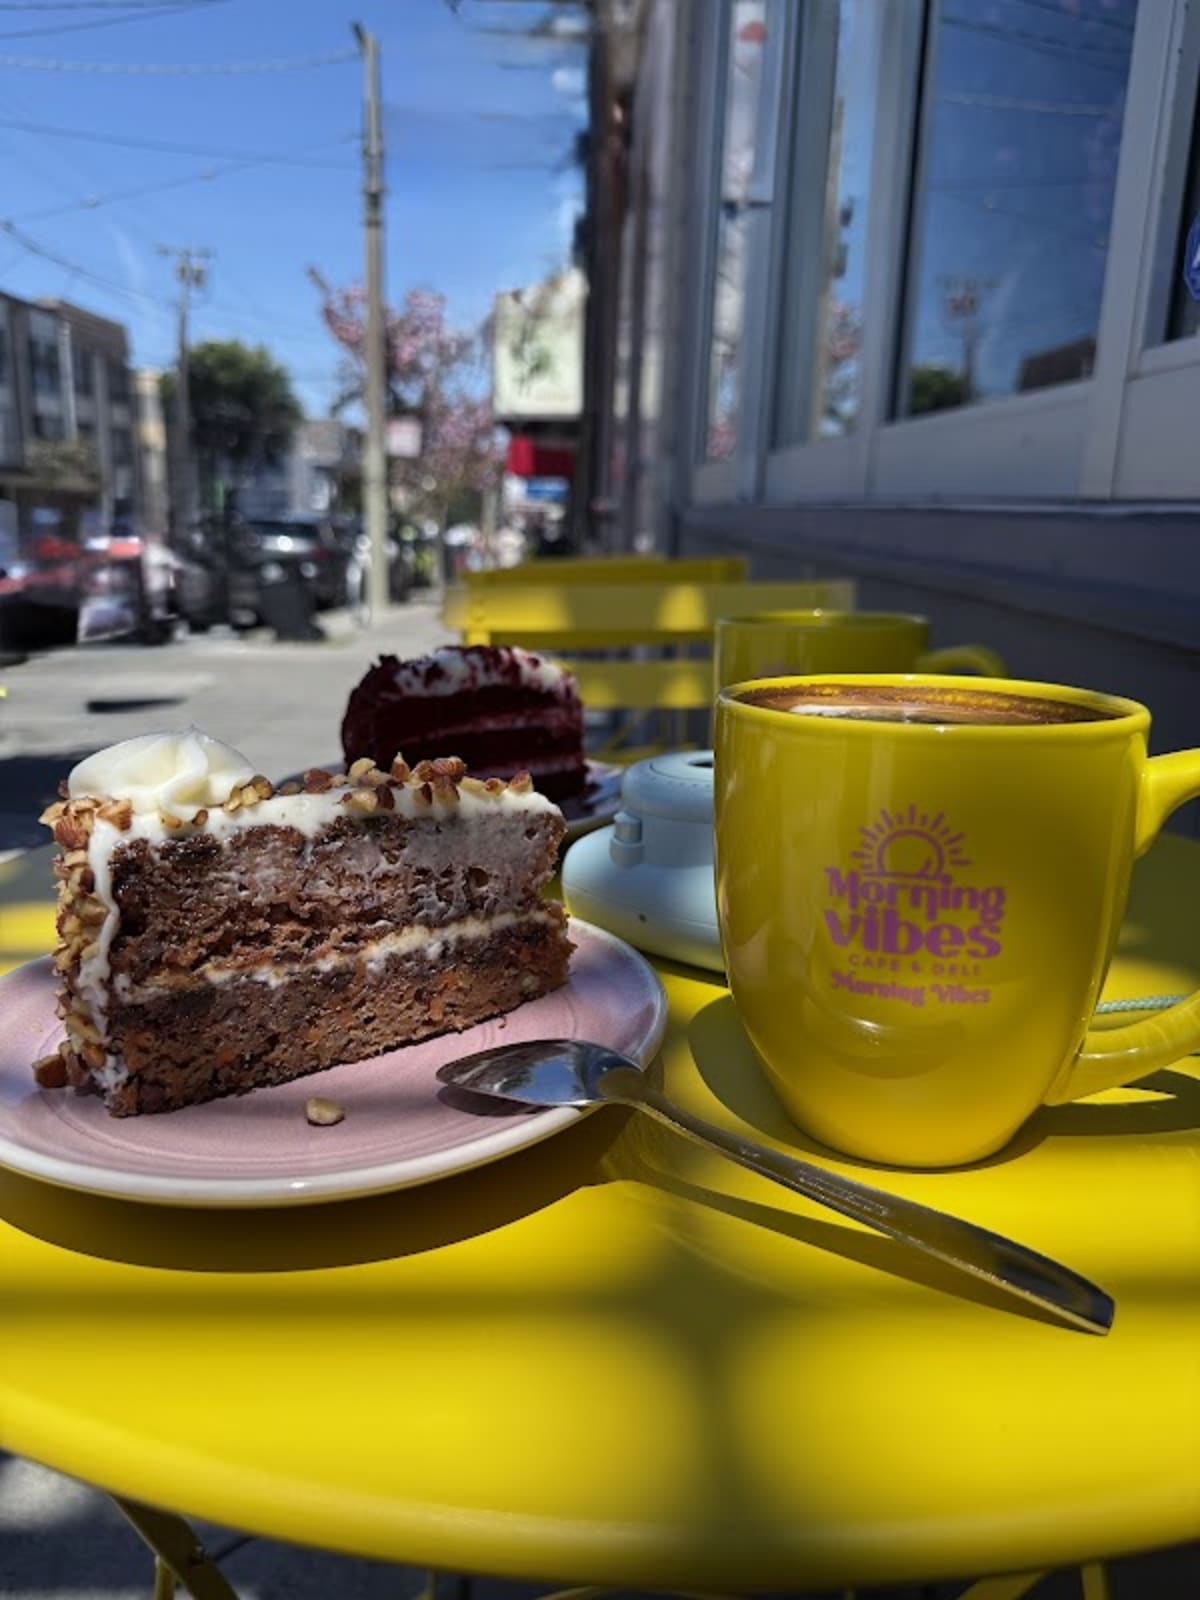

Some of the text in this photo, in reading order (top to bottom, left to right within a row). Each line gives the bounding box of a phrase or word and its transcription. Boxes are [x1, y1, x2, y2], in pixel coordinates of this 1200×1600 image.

[824, 867, 1006, 933] Morning
[831, 970, 926, 1007] Morning
[932, 964, 980, 977] DELI
